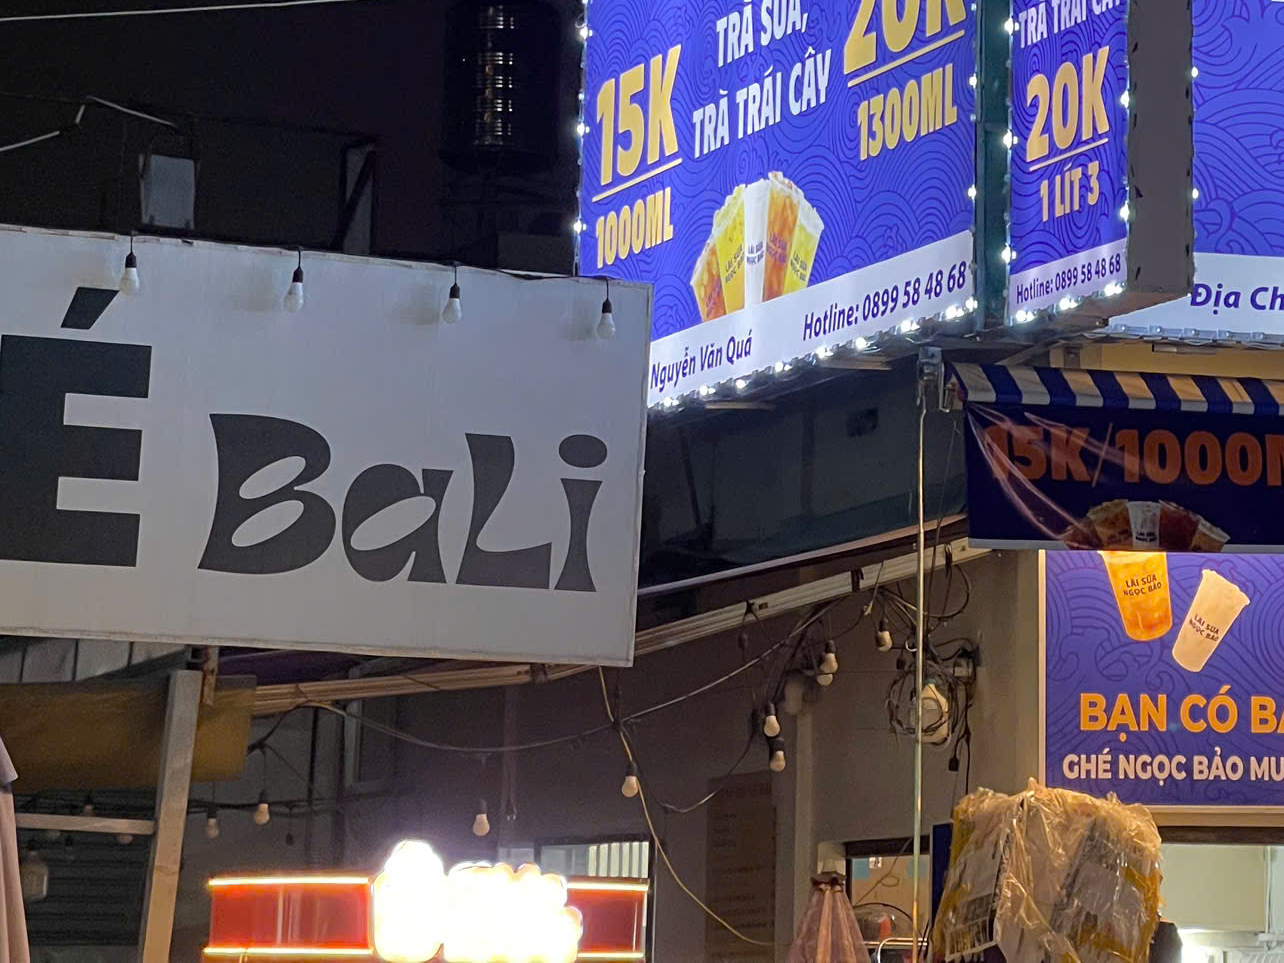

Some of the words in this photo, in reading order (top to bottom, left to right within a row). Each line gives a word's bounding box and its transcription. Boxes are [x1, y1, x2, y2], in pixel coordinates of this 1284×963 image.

[596, 44, 682, 186] 15K
[692, 90, 730, 159] TRÀ
[736, 66, 781, 137] TRÁI
[789, 48, 832, 116] CÂY
[857, 63, 958, 161] 1300ML
[1026, 46, 1110, 163] 20K
[596, 186, 675, 268] 1000ML
[1054, 162, 1085, 217] LÍT
[802, 300, 860, 341] Hotline:
[862, 284, 900, 318] 0899
[902, 279, 921, 307] 58
[924, 273, 943, 301] 48
[947, 260, 967, 291] 68
[1190, 283, 1243, 319] Địa
[649, 345, 697, 394] Nguyễn
[699, 342, 723, 371] Văn
[725, 330, 753, 369] Quá
[1080, 692, 1168, 742] BẠN
[1179, 685, 1238, 734] CÓ
[1063, 748, 1112, 781] GHÉ
[1118, 753, 1187, 786] NGỌC
[1193, 745, 1244, 781] BẢO
